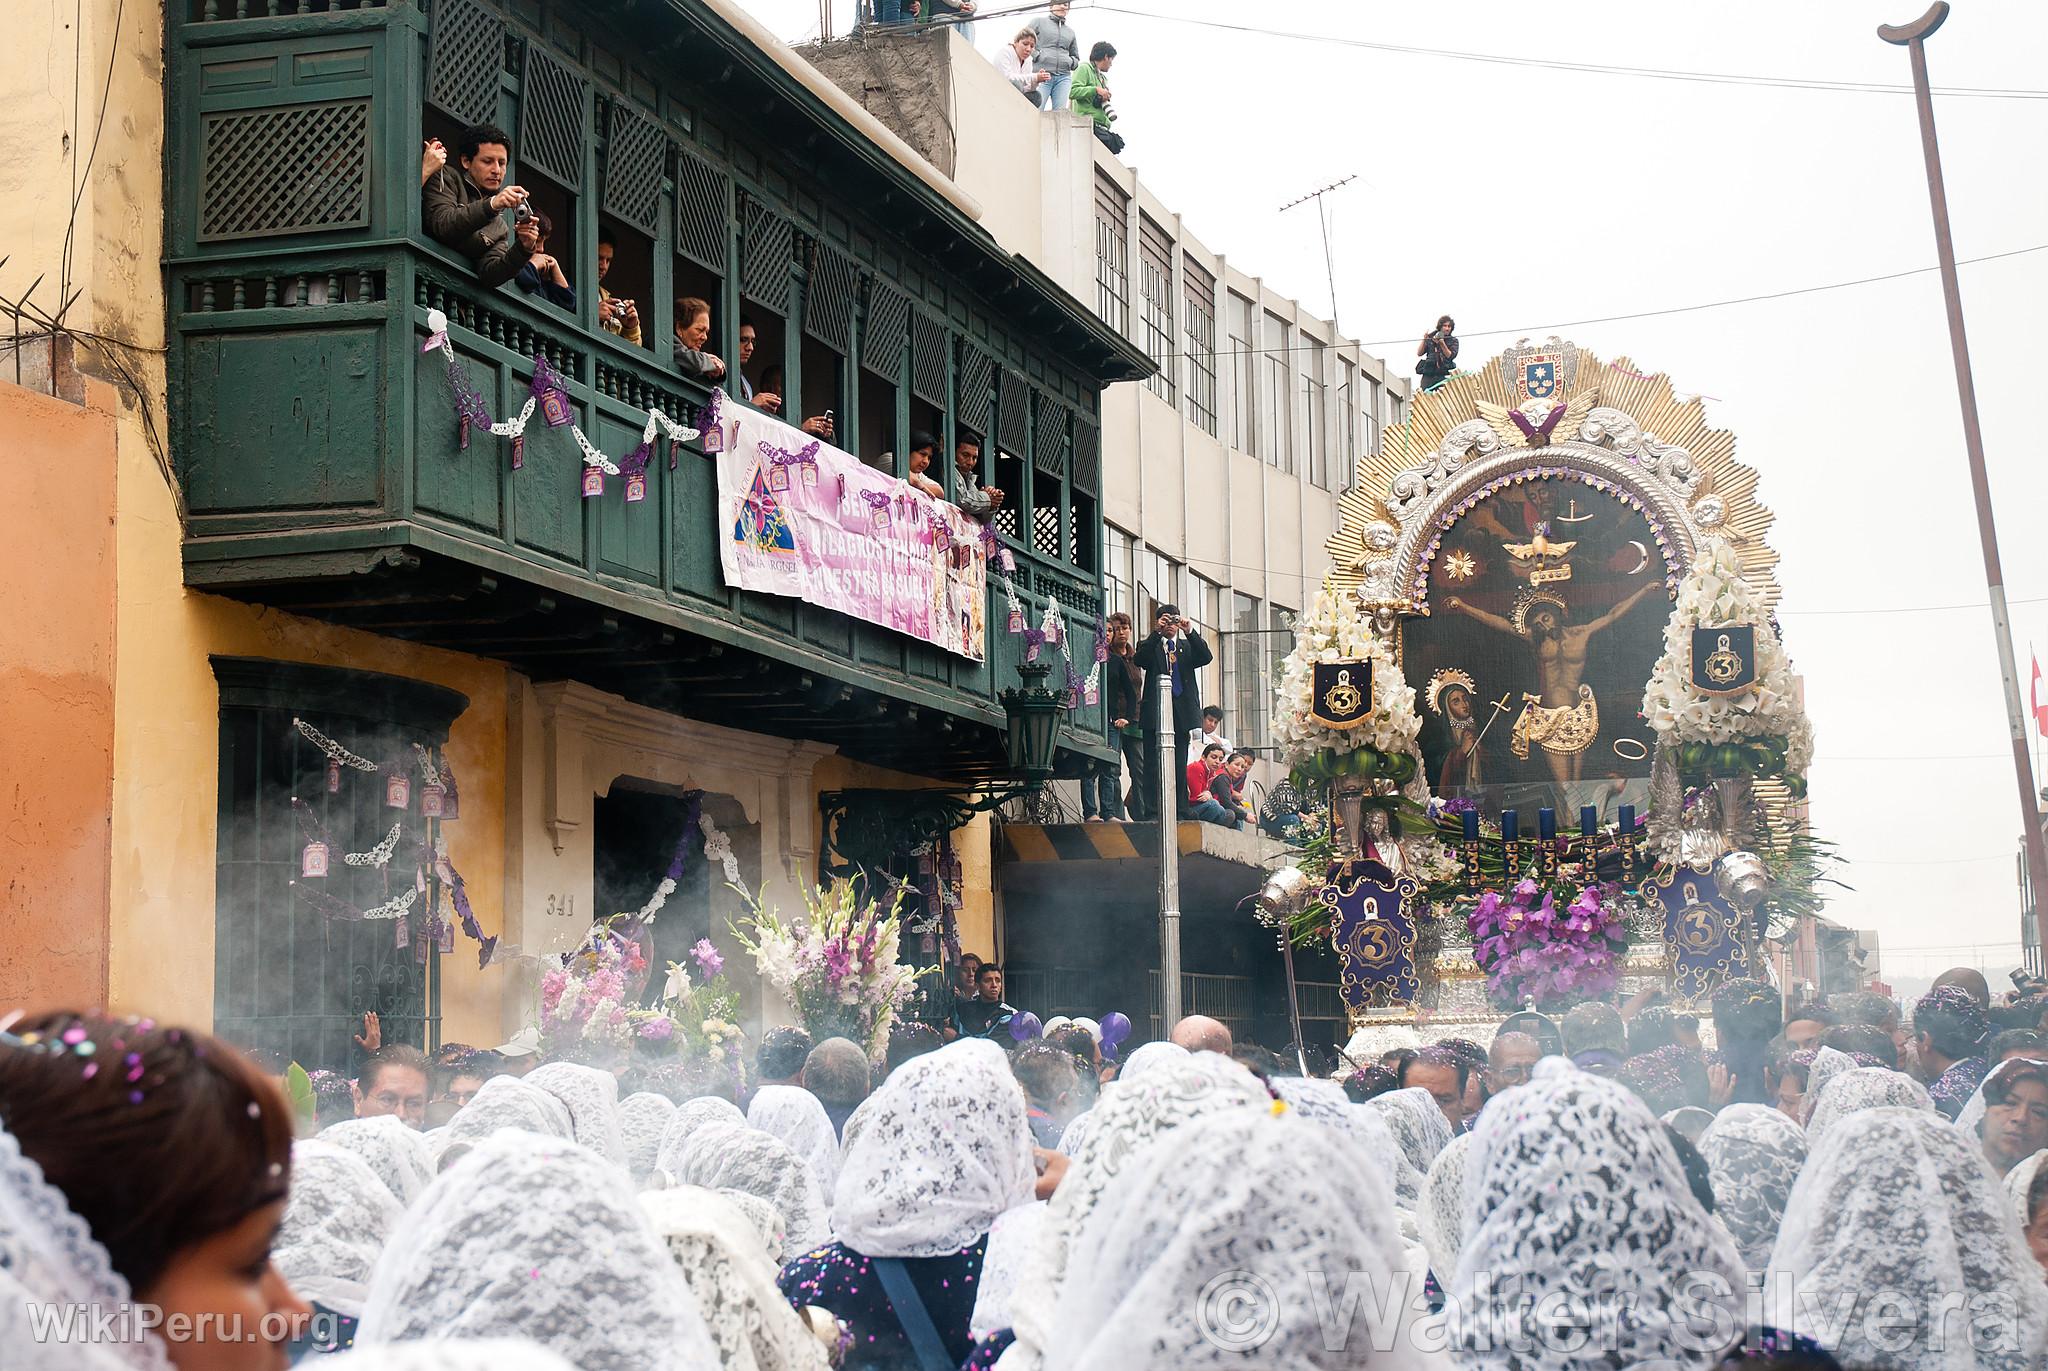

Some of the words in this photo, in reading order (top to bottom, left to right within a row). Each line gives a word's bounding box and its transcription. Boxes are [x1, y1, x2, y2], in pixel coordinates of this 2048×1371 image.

[1714, 655, 1732, 677] 3
[1334, 690, 1351, 709] 3
[1467, 851, 1479, 874] 3
[1508, 853, 1519, 874] 3
[1544, 852, 1555, 873] 3
[1584, 848, 1596, 870] 3
[1622, 847, 1634, 870] 3
[546, 893, 574, 917] 341
[1686, 910, 1713, 947] 3
[1361, 926, 1388, 961] 3
